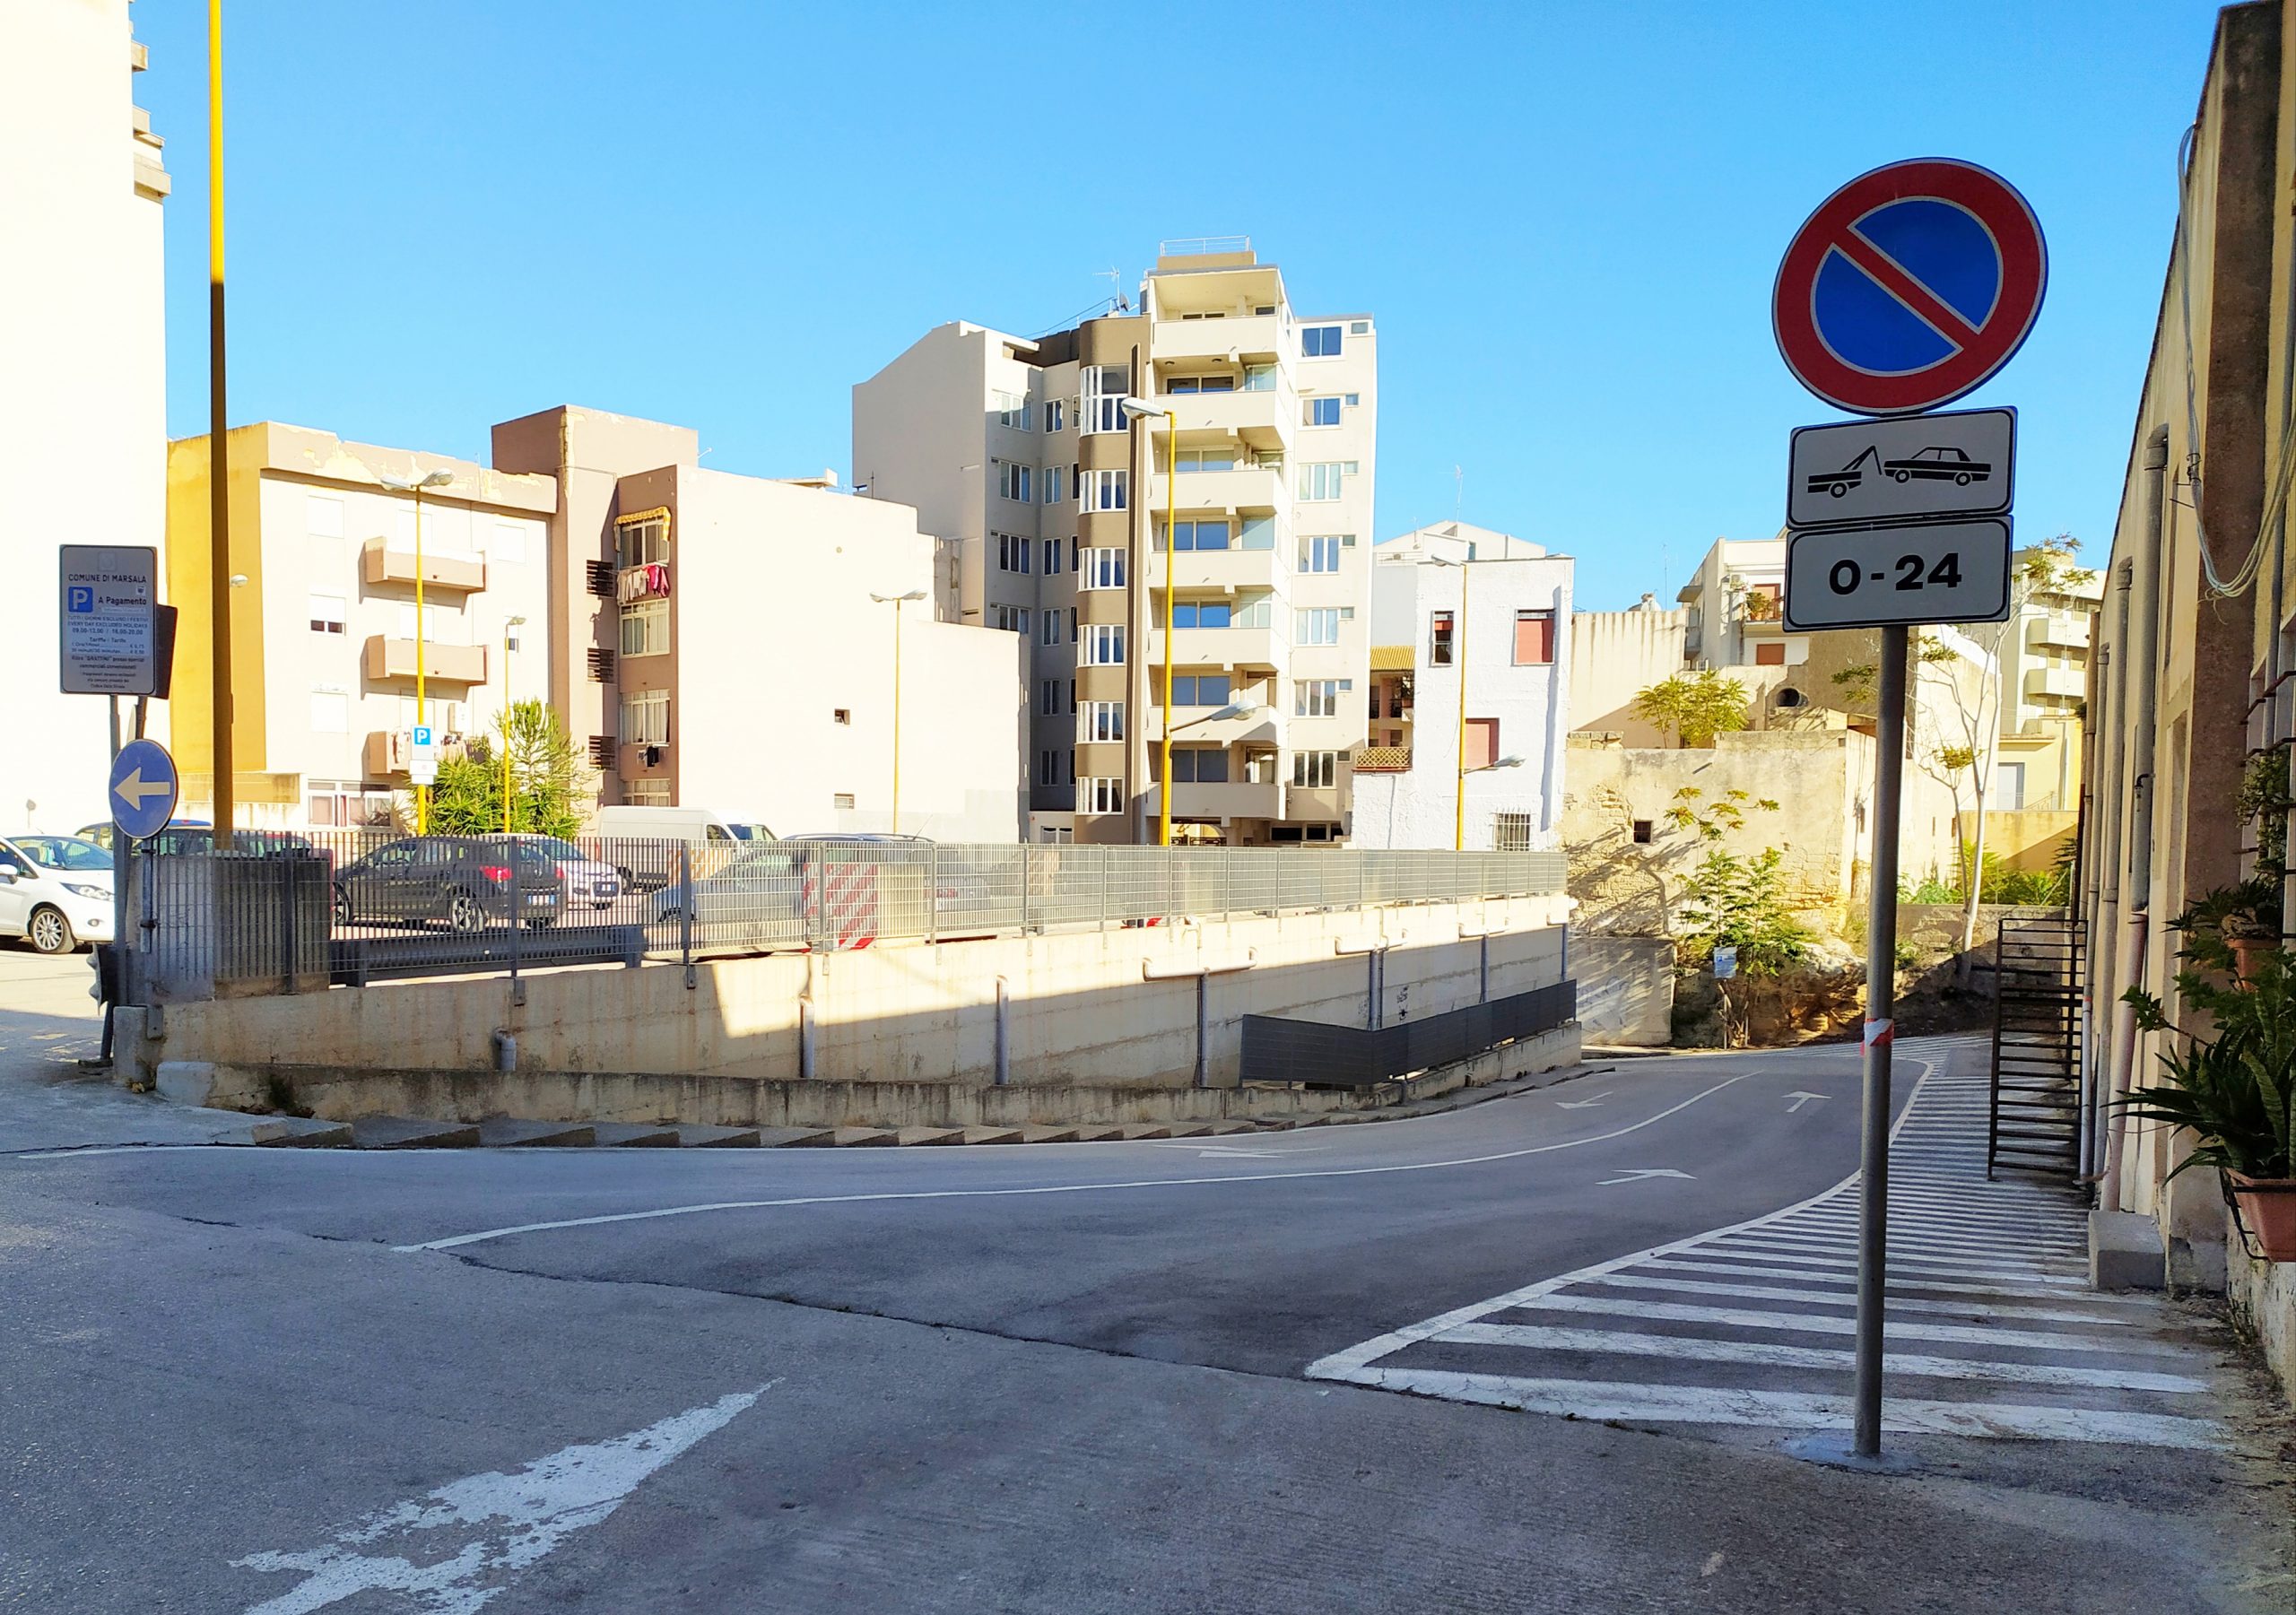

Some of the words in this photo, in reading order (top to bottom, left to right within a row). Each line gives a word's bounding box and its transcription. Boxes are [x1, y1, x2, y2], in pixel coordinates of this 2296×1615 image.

[68, 574, 100, 582] COMUNE
[112, 575, 147, 583] MARSALA
[73, 588, 88, 610] P
[106, 596, 147, 606] Pagamento
[417, 729, 428, 743] P
